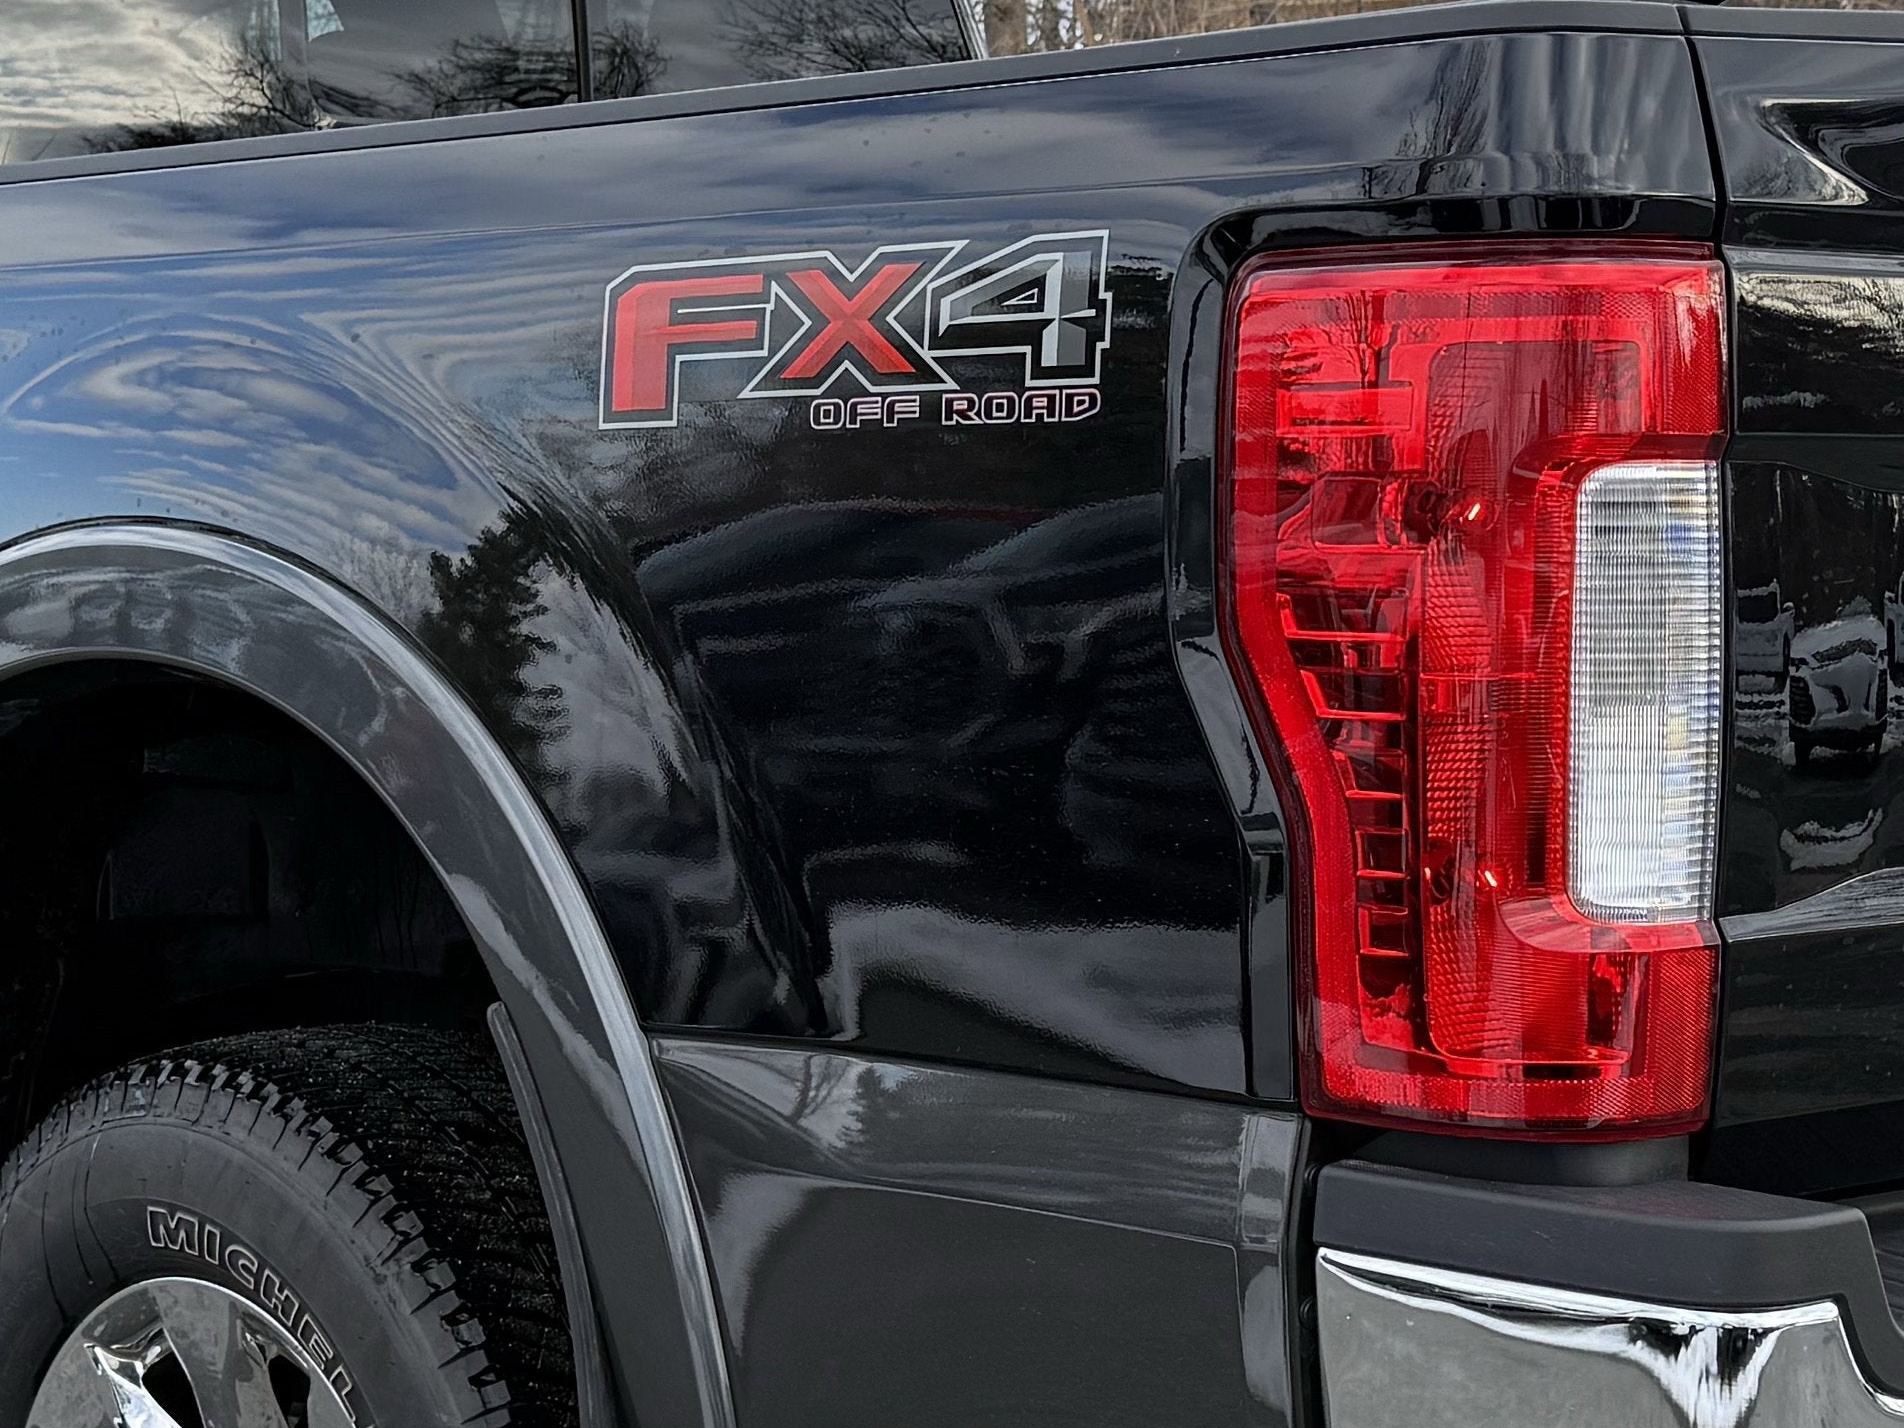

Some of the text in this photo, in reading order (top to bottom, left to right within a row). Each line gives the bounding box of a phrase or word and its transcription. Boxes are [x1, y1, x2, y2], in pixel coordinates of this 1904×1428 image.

[599, 229, 1112, 429] FX4
[809, 388, 1102, 430] OFF ROAD
